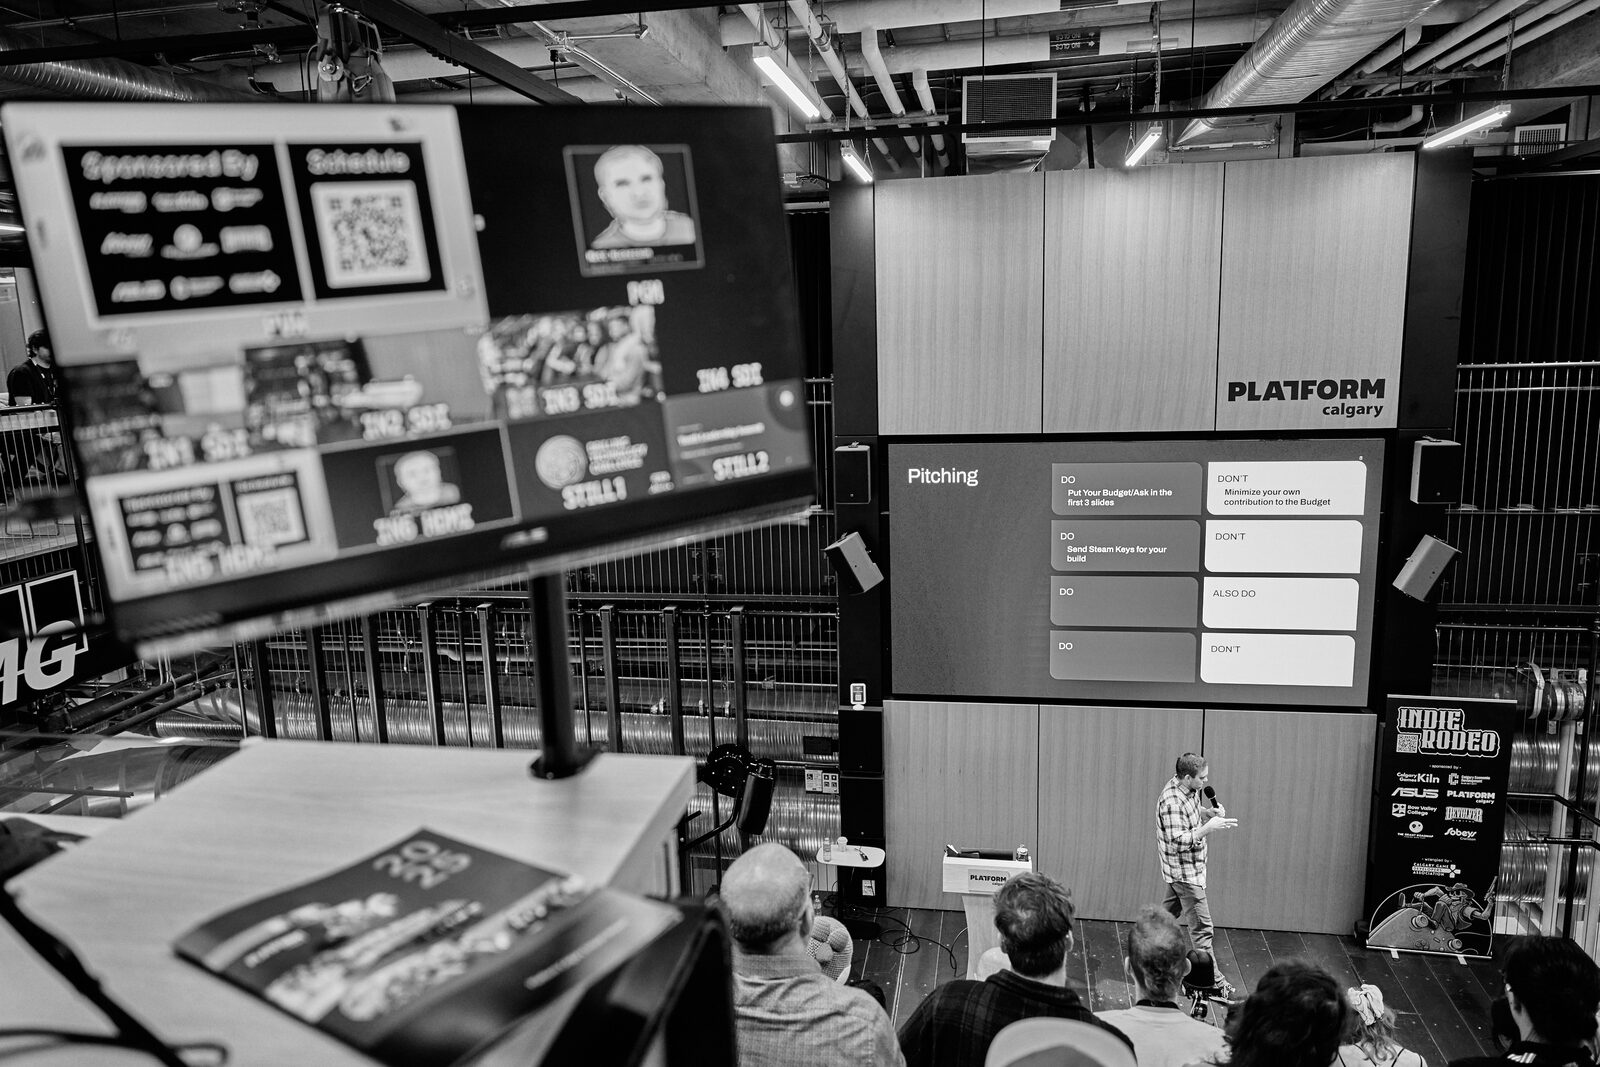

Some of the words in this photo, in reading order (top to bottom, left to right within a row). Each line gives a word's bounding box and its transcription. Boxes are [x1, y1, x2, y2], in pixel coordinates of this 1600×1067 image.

[306, 148, 411, 175] Schedule
[81, 150, 223, 184] Sponsored
[222, 149, 259, 182] By
[696, 366, 731, 393] IN4
[731, 362, 764, 388] SDI
[1228, 378, 1386, 402] PLATFORM
[1322, 403, 1384, 418] calgary
[712, 451, 770, 482] STILL2
[908, 467, 979, 487] Pitching
[1060, 475, 1076, 484] DO
[1217, 474, 1249, 483] DON'T
[1067, 489, 1082, 497] Put
[1082, 489, 1101, 497] Your
[1102, 489, 1149, 498] Budget/Ask
[1150, 489, 1158, 497] in
[1158, 489, 1173, 497] the
[1224, 488, 1261, 496] Minimize
[1262, 489, 1282, 497] your
[1091, 498, 1115, 506] slides
[1223, 498, 1273, 506] contribution
[1275, 498, 1284, 506] to
[1285, 498, 1299, 506] the
[1300, 498, 1331, 507] Budget
[1060, 532, 1075, 541] DO
[1215, 532, 1246, 541] DON'T
[1066, 545, 1088, 553] Send
[1089, 545, 1114, 553] Steam
[1115, 545, 1135, 554] Keys
[1136, 545, 1148, 553] for
[1148, 546, 1168, 555] your
[1066, 554, 1087, 563] build
[1059, 588, 1074, 596] DO
[1212, 589, 1239, 598] ALSO
[1241, 589, 1256, 598] DO
[1058, 642, 1074, 650] DO
[1210, 645, 1241, 653] DON'T
[1399, 708, 1461, 731] INDIE
[1420, 729, 1496, 752] RODEO
[1417, 773, 1440, 783] Kiln
[1391, 787, 1439, 799] ASUS
[1446, 790, 1496, 800] PLATFORM
[1407, 809, 1429, 817] College
[1444, 827, 1477, 838] Sobeys
[970, 874, 1007, 882] PLATFORM
